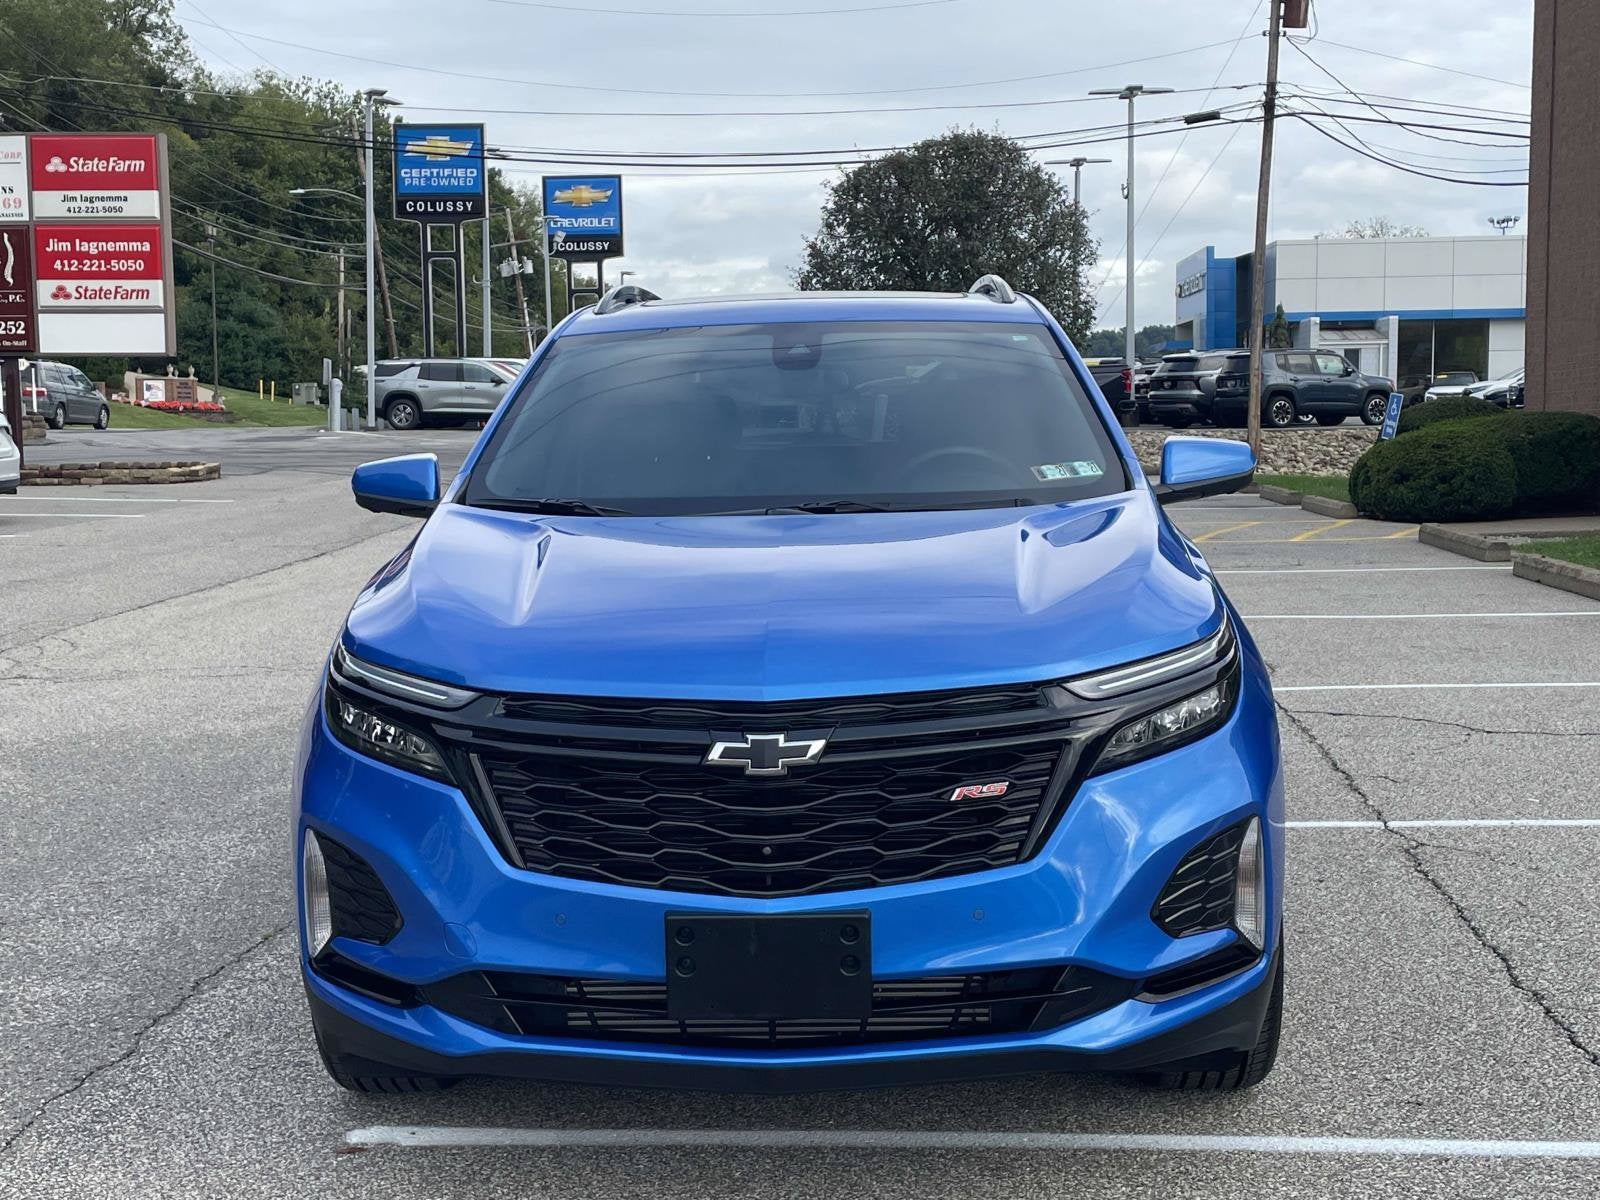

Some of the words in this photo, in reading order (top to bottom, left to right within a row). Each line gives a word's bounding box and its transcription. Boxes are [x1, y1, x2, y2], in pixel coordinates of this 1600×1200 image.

[400, 168, 478, 177] CERTIFIED
[404, 178, 474, 186] PRE-OWNED
[61, 194, 79, 203] Jim
[80, 194, 128, 204] Iagnemma
[66, 206, 124, 214] 412-221-5050
[406, 201, 473, 212] COLUSSY
[550, 217, 616, 228] CHEVROLET
[46, 238, 72, 252] Jim
[75, 238, 151, 254] Iagnemma
[557, 241, 610, 251] COLUSSY
[53, 260, 145, 272] 412-221-5050
[950, 781, 1009, 801] RS
